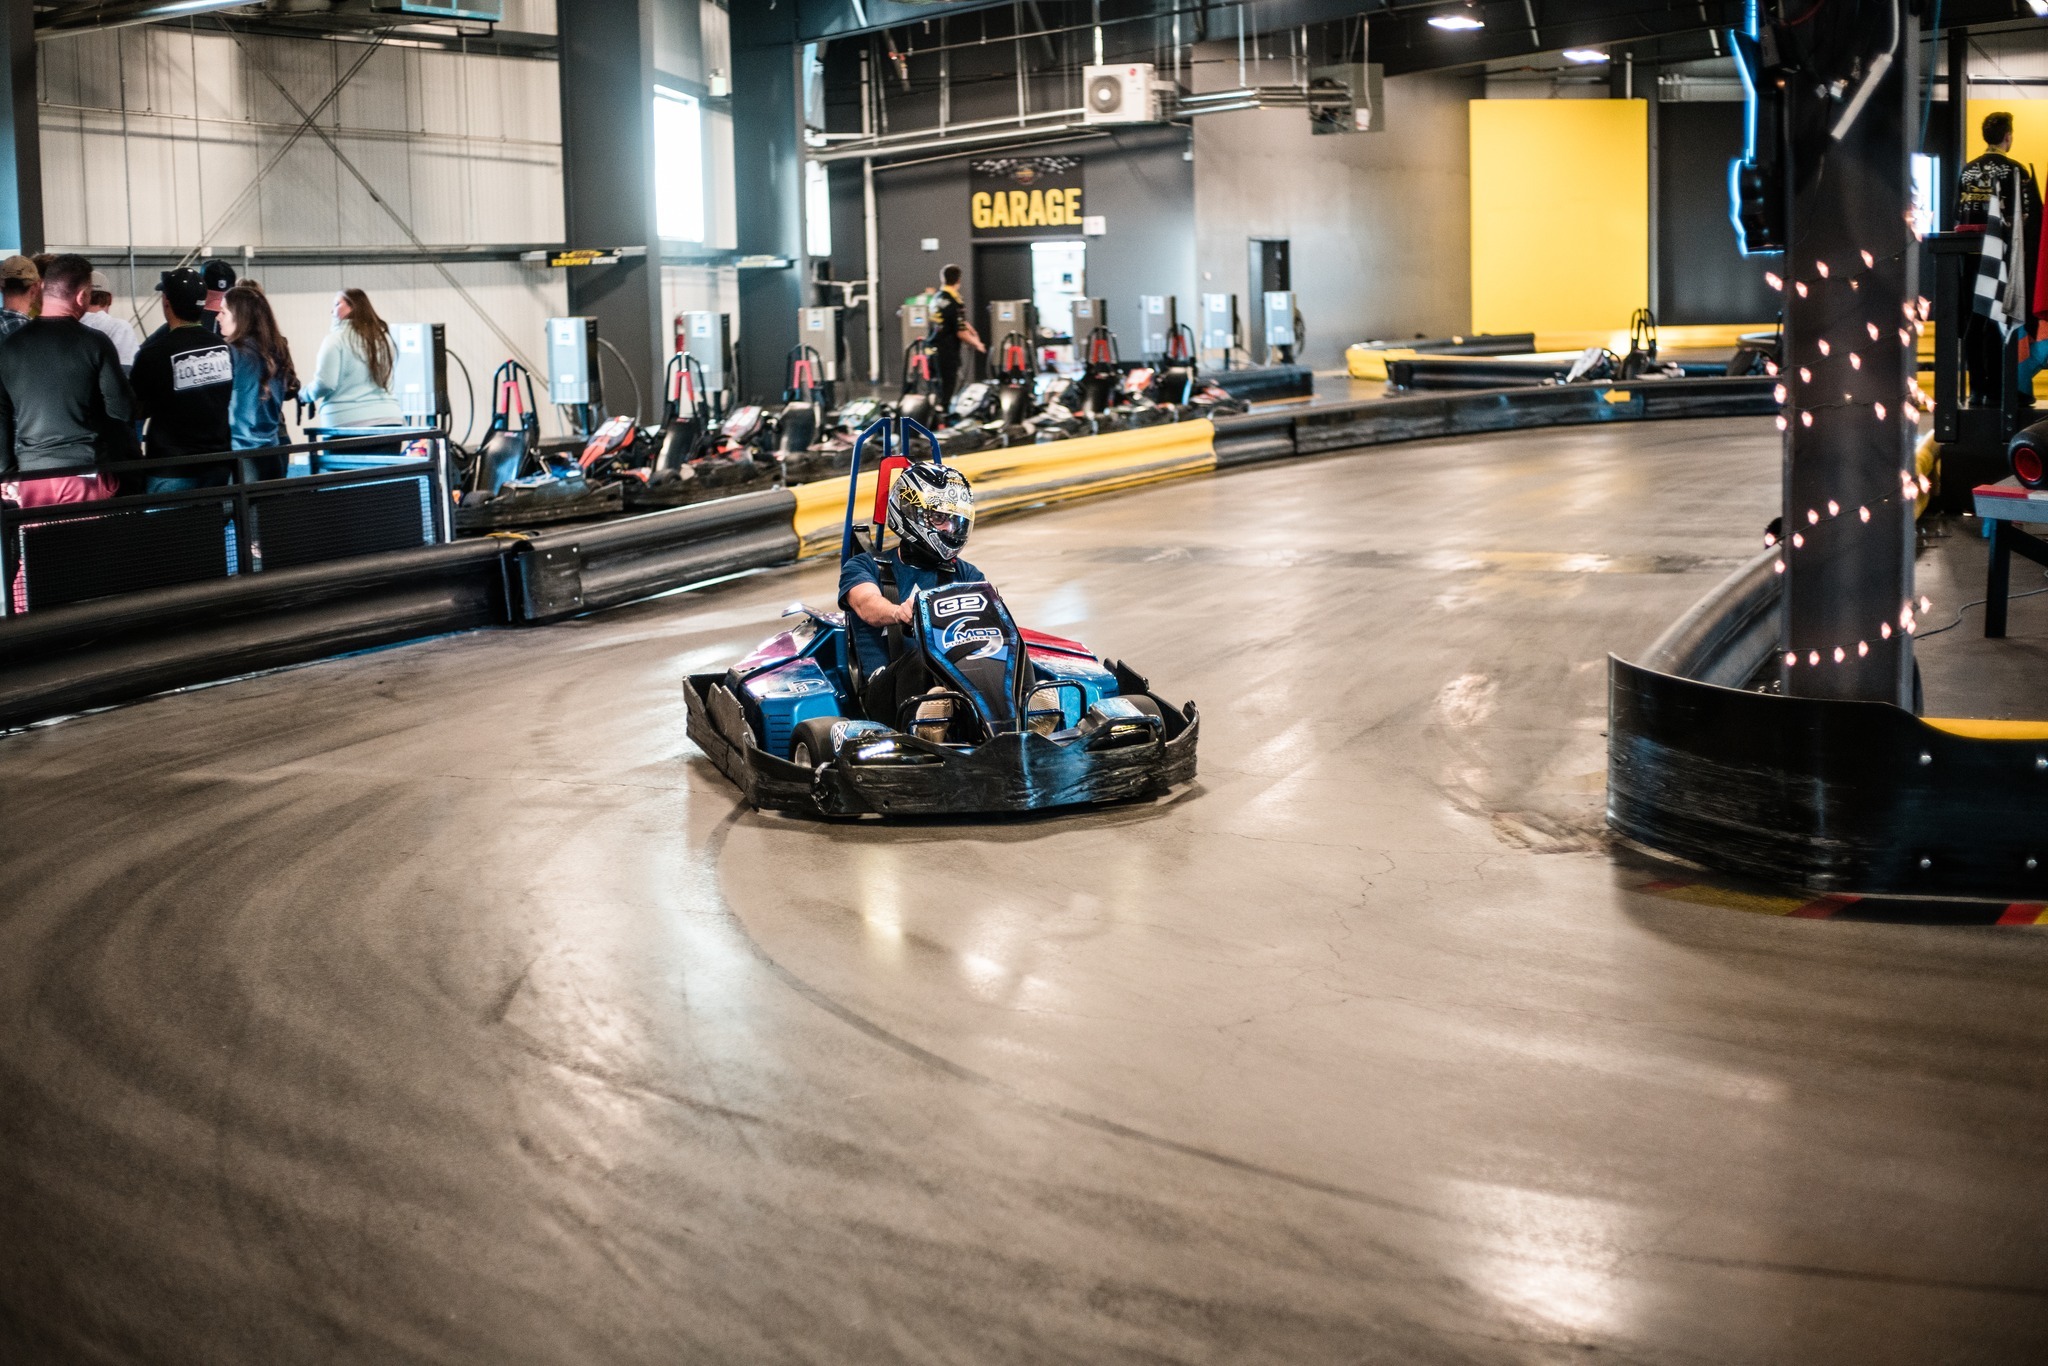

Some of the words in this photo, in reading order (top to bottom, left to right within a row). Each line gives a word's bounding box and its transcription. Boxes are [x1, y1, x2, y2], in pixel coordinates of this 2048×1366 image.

[972, 188, 1082, 229] GARAGE
[552, 257, 591, 267] ENERGY
[198, 362, 216, 376] SEA
[939, 596, 981, 614] 32
[956, 628, 1000, 640] MOD
